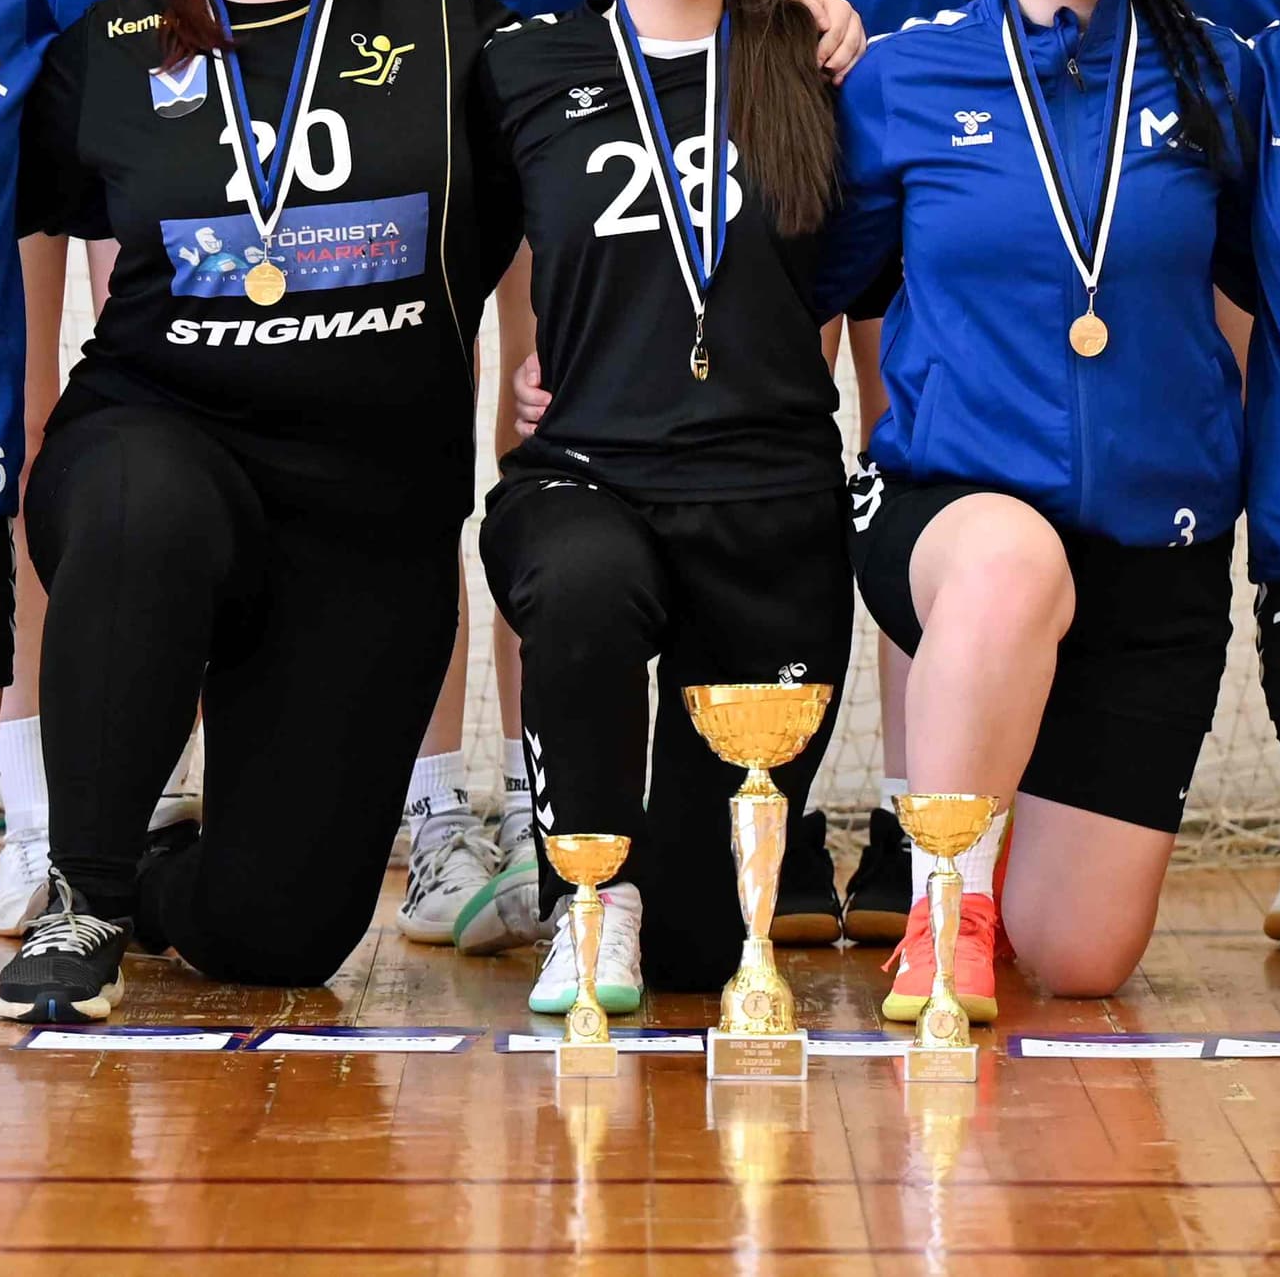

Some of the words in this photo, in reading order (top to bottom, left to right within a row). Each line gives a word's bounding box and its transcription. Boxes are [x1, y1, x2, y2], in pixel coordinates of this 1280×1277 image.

[219, 108, 353, 203] 20
[951, 131, 993, 147] hummel
[585, 135, 744, 238] 28
[265, 222, 400, 248] TÖÖRIISTA
[296, 240, 400, 263] MARKET
[301, 265, 340, 275] SAAB
[166, 301, 426, 347] STIGMAR
[1168, 507, 1197, 547] 3
